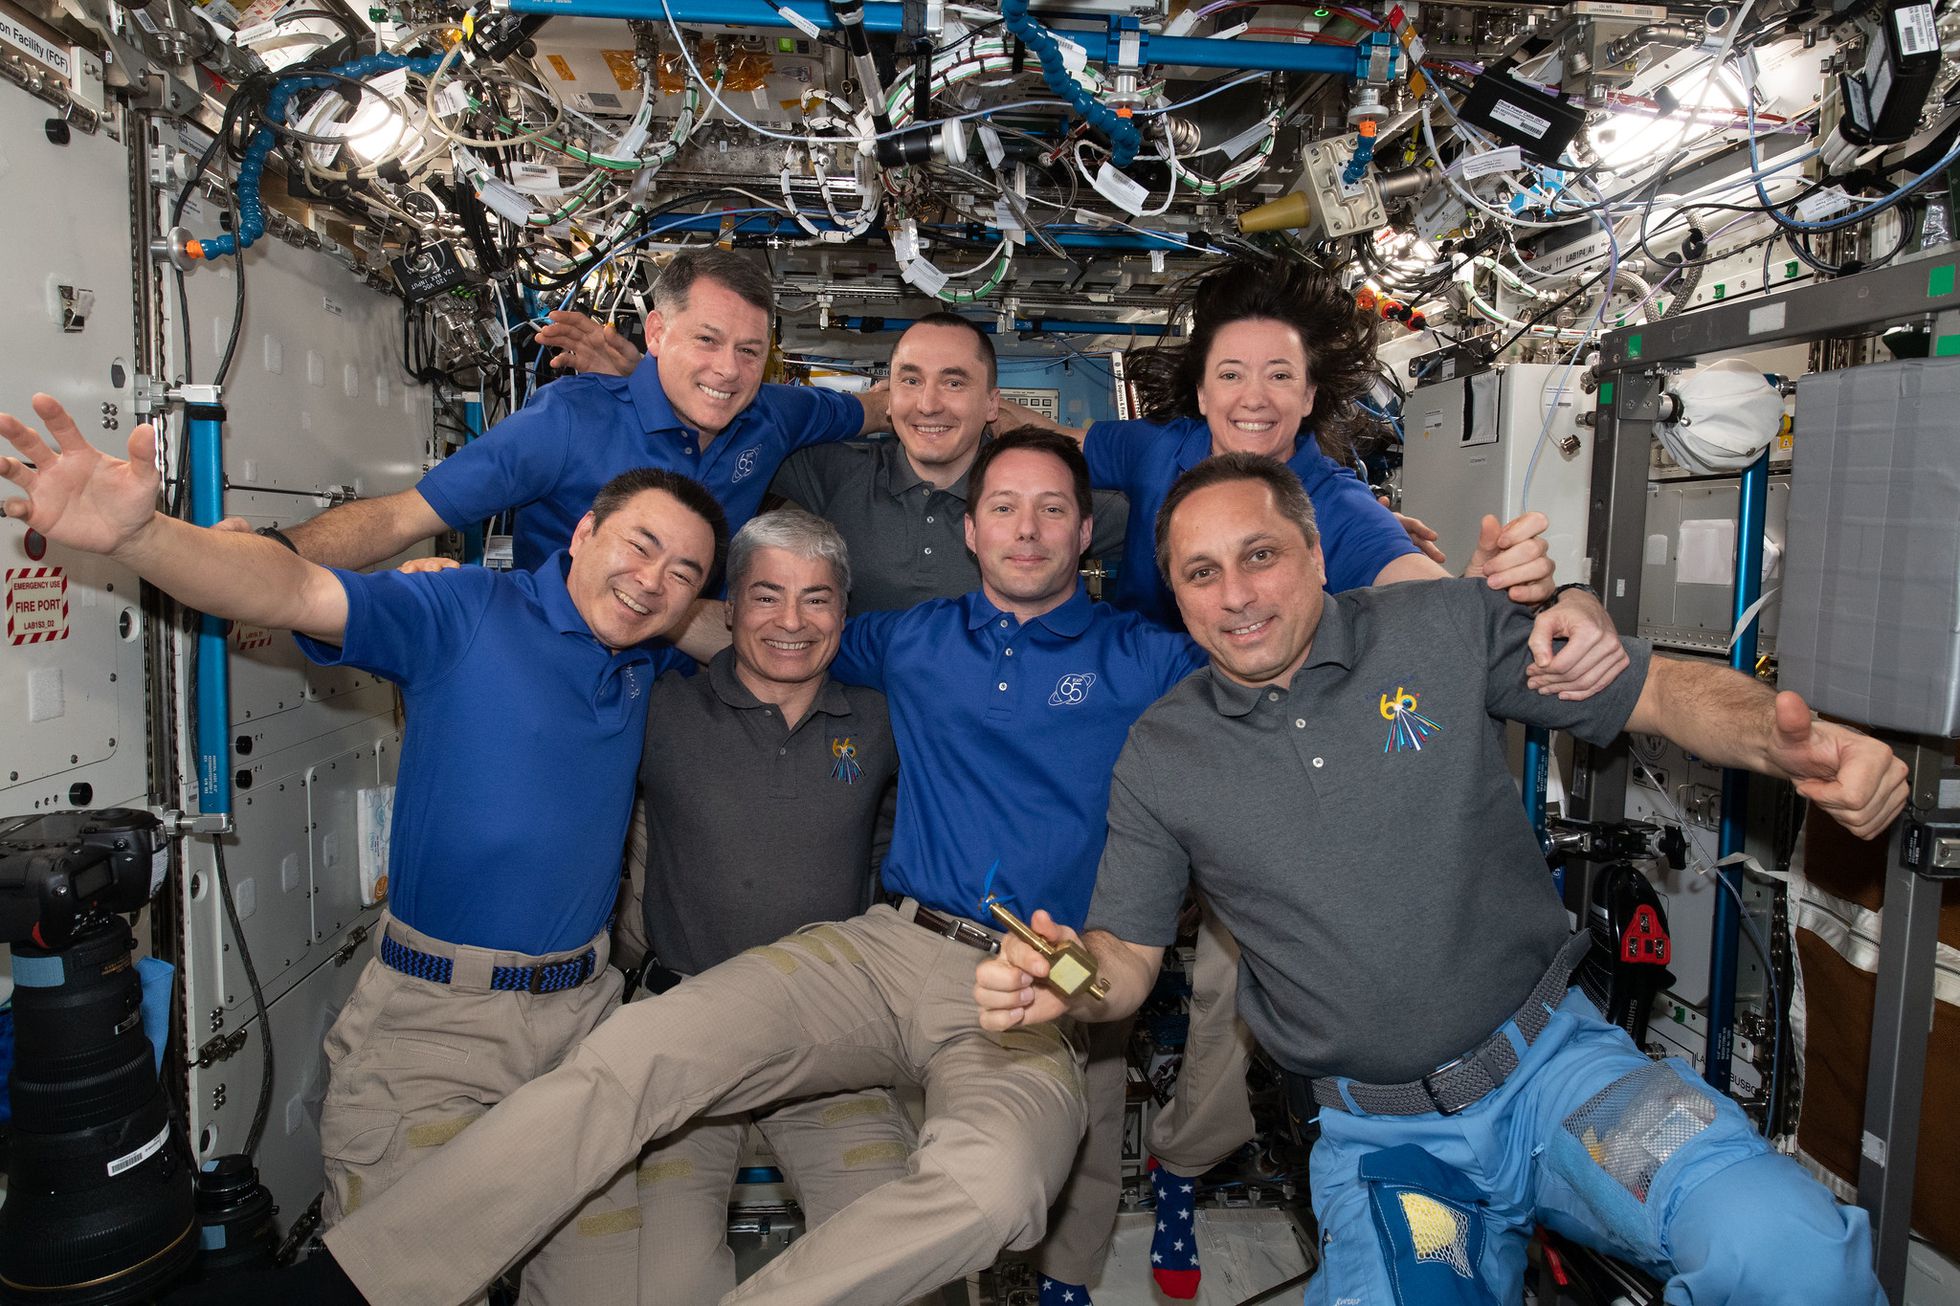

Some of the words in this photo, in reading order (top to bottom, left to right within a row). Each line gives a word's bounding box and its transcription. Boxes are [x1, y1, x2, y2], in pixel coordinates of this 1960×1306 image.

[13, 28, 45, 58] Facility
[46, 48, 69, 73] (FCF)
[1541, 264, 1552, 273] Rack
[1556, 256, 1562, 267] 11
[411, 279, 428, 290] INPUT
[14, 582, 48, 590] EMERGENCY
[16, 601, 36, 613] FIRE
[38, 599, 60, 611] PORT
[1060, 676, 1082, 701] 65
[1380, 686, 1417, 720] 66
[832, 738, 856, 758] 66
[1626, 999, 1638, 1034] SHIMA
